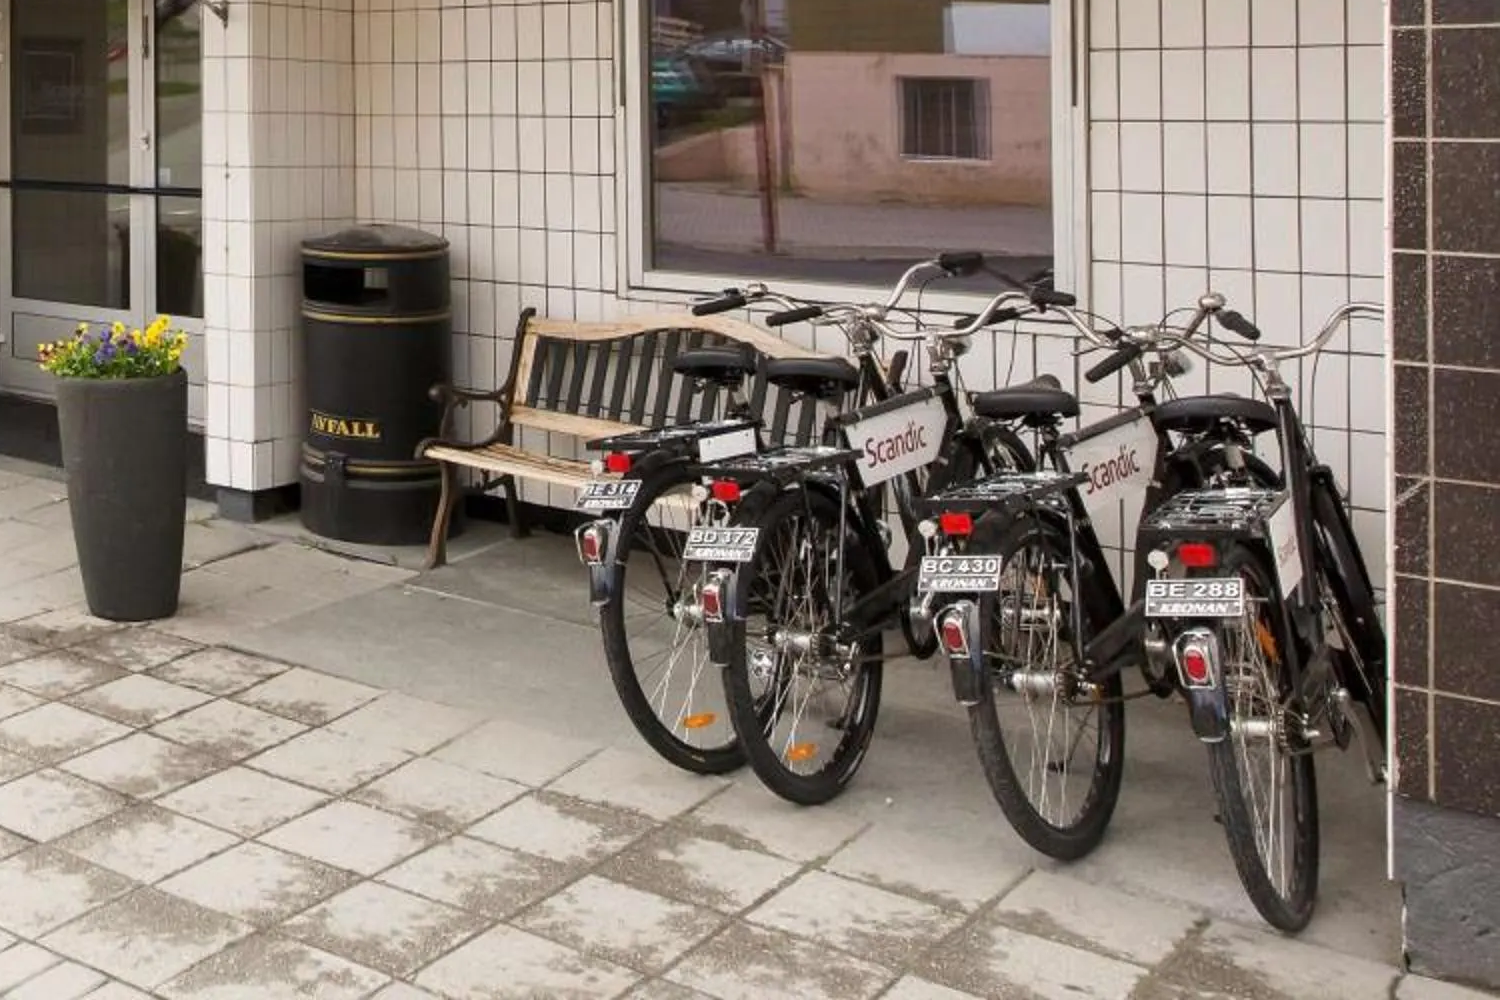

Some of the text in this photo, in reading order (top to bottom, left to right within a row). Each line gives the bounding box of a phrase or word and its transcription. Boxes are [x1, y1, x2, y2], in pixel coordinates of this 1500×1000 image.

[865, 420, 927, 469] Scandic
[1082, 444, 1140, 495] Scandic
[923, 559, 997, 573] BC 430
[1149, 582, 1239, 597] BE 288
